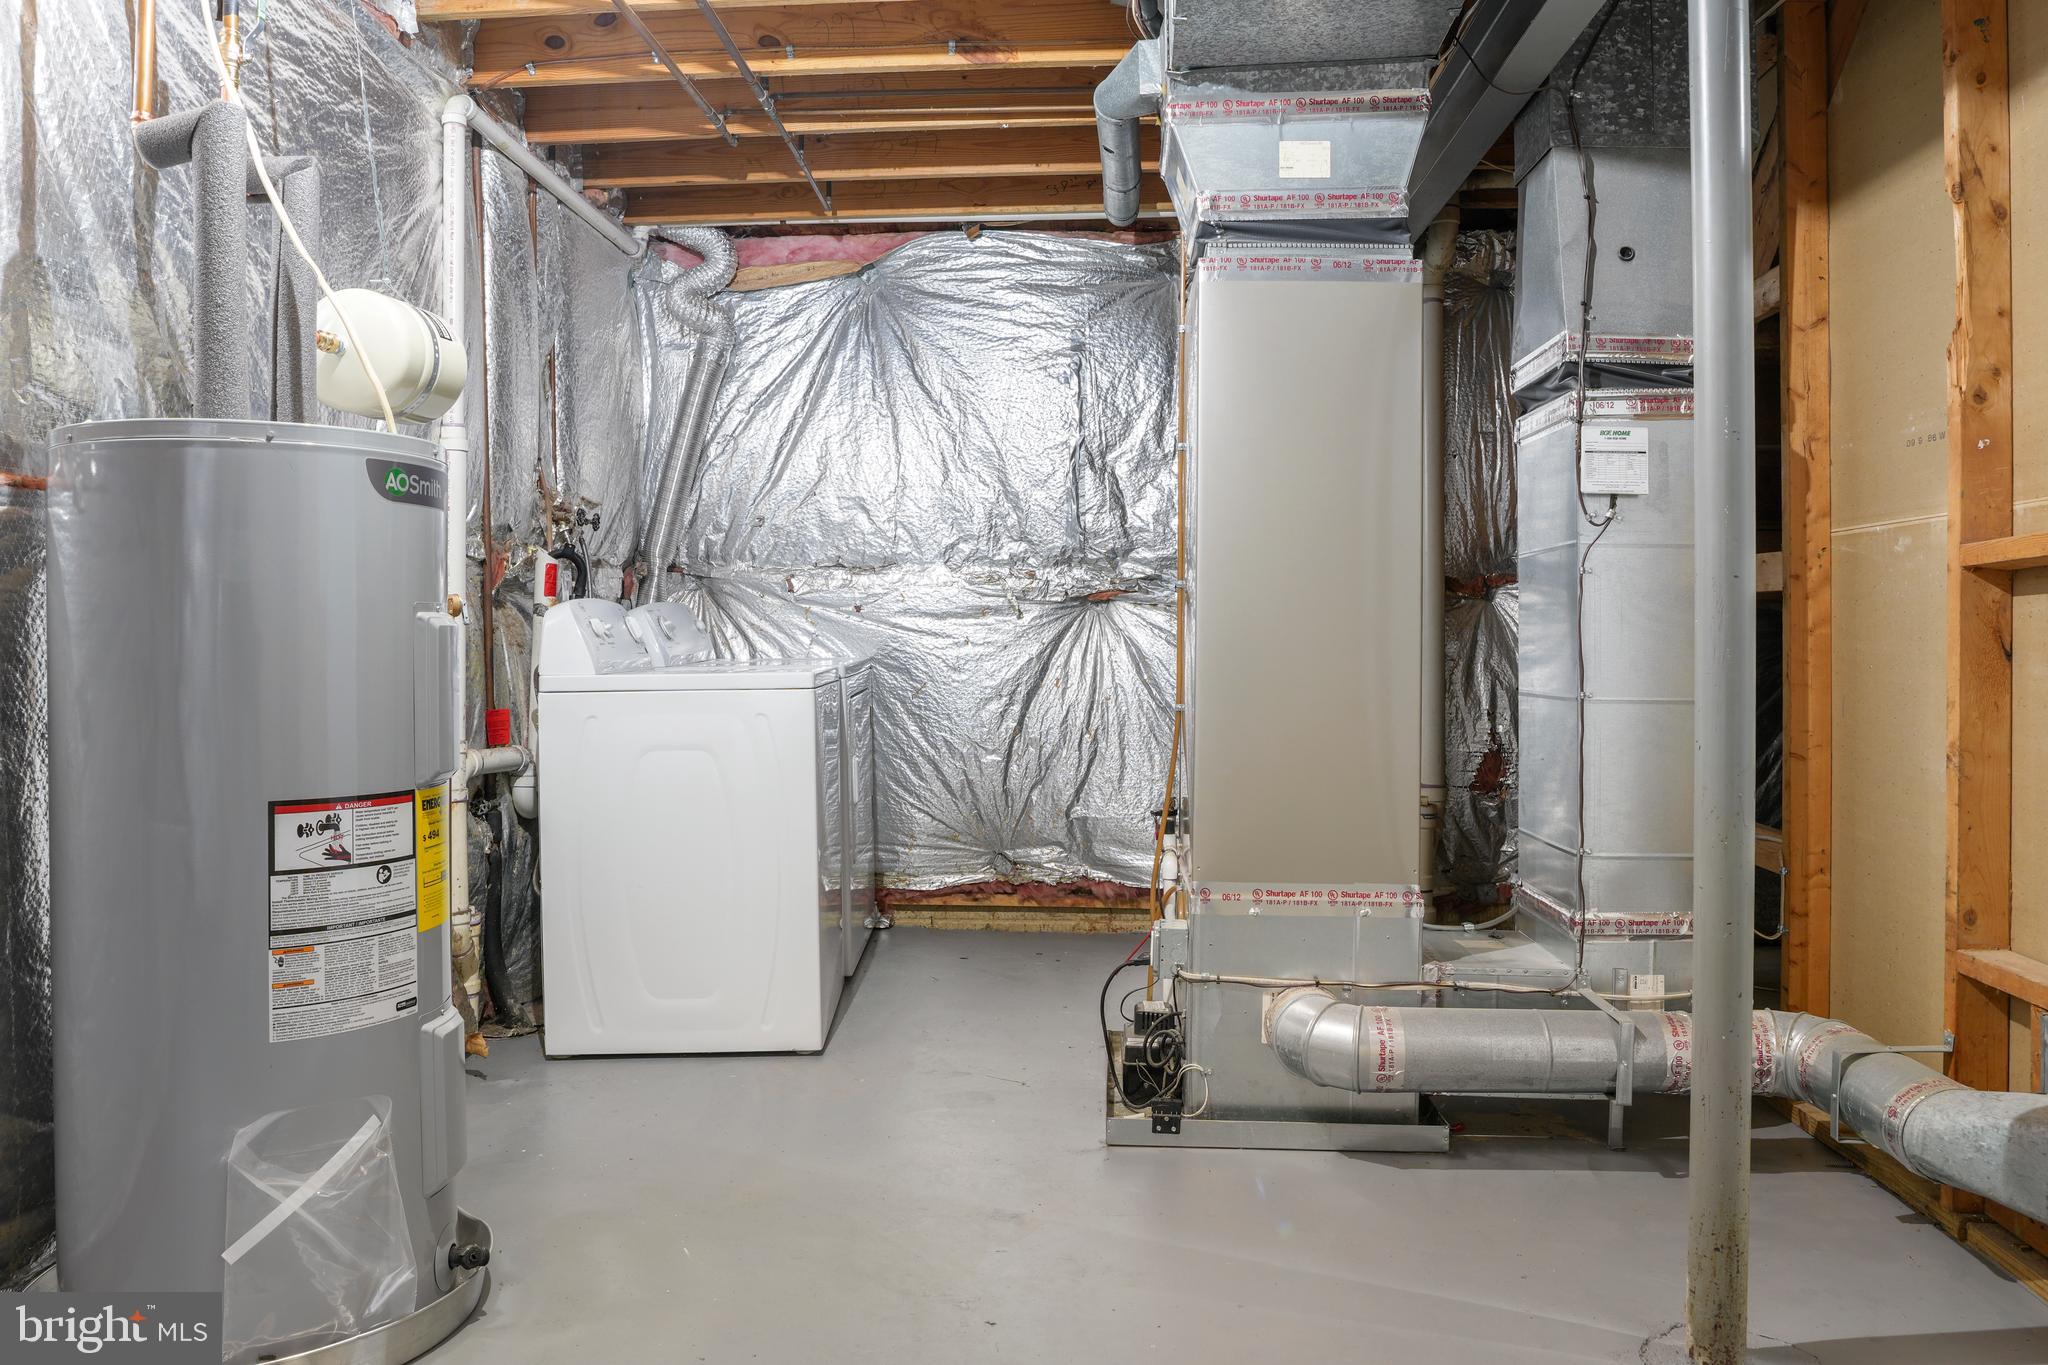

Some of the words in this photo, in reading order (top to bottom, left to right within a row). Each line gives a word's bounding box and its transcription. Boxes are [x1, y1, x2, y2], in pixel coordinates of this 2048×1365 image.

[1207, 100, 1218, 108] 100
[1236, 99, 1265, 108] Shurtape
[1308, 98, 1338, 106] Shurtape
[1382, 96, 1412, 104] Shurtape
[1333, 261, 1352, 269] 06/12
[1222, 893, 1241, 902] 06/12
[1266, 889, 1296, 898] Shurtape
[1341, 890, 1370, 900] Shurtape
[1628, 919, 1658, 928] Shurtape
[1377, 1027, 1384, 1036] AF
[1378, 1040, 1387, 1072] Shurtape
